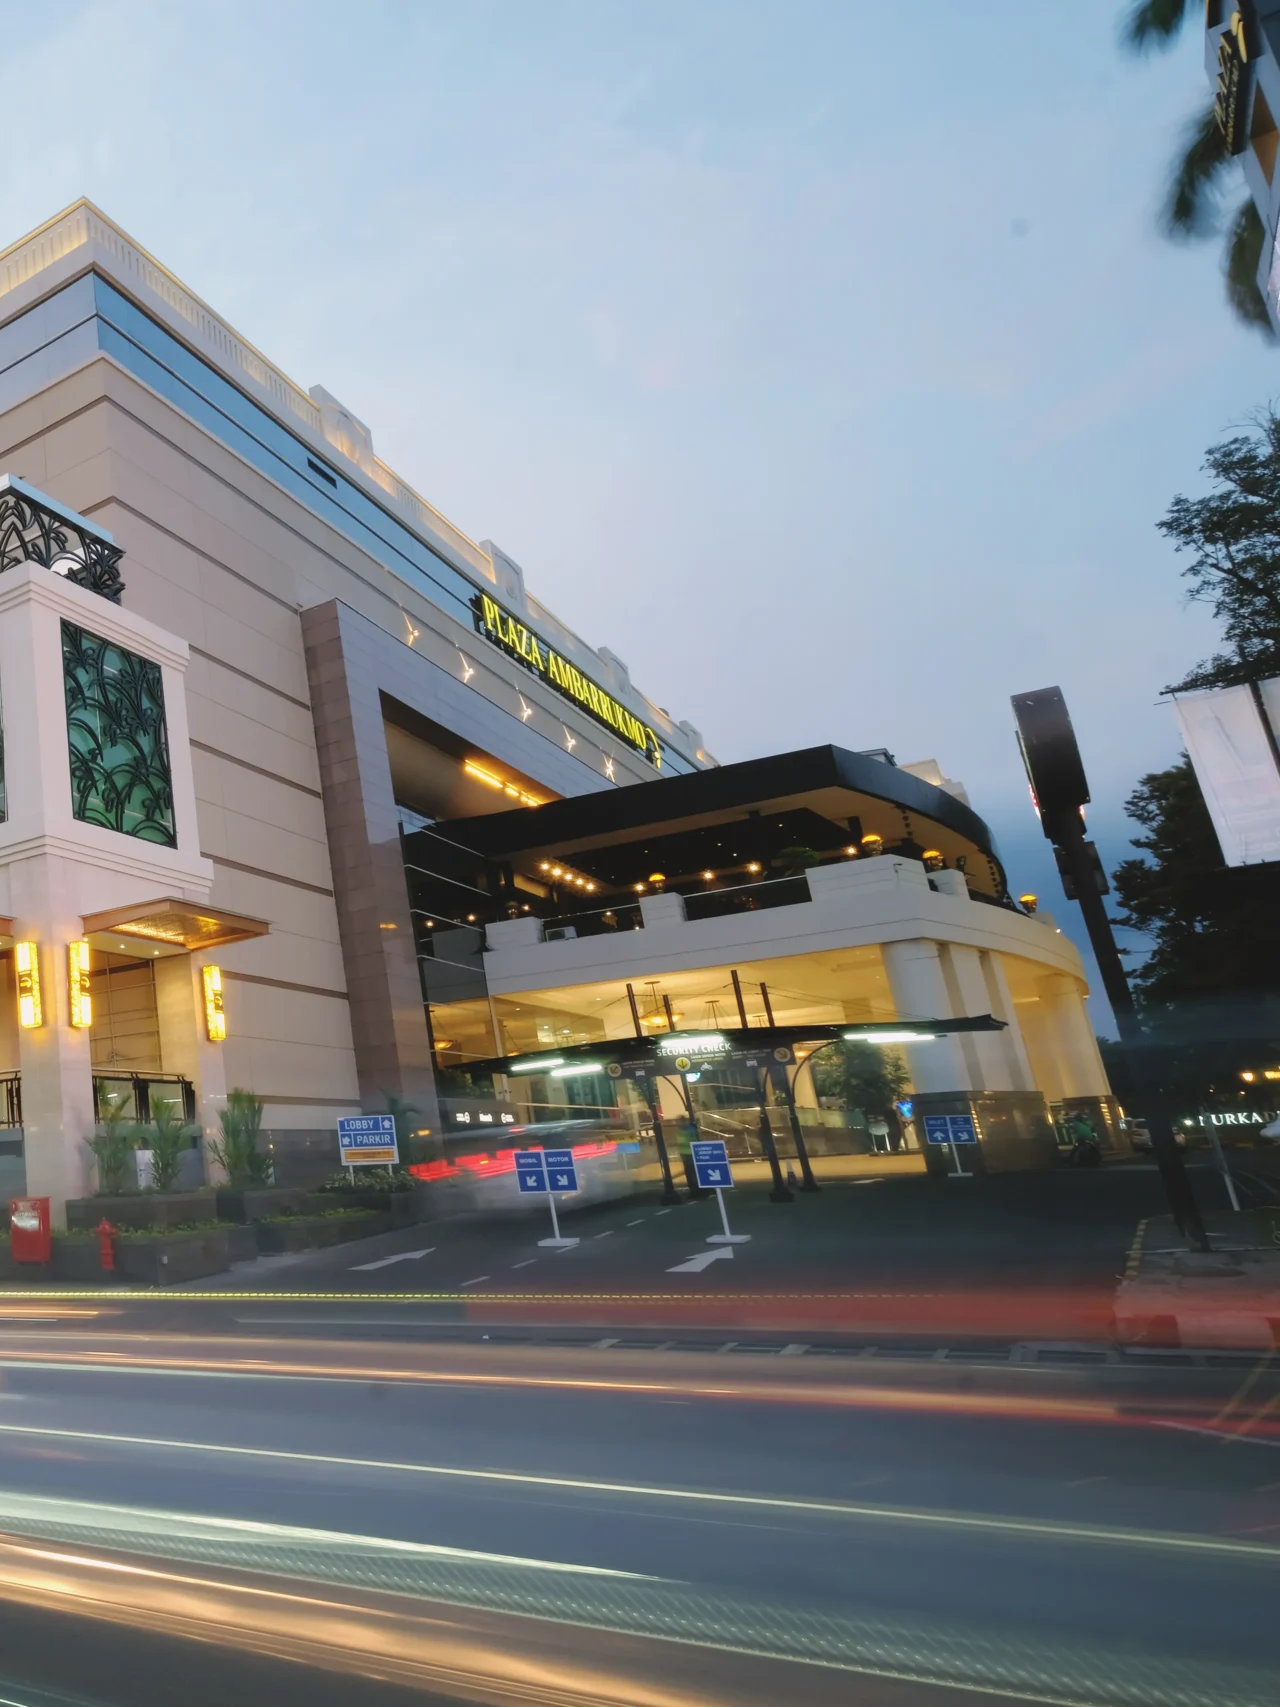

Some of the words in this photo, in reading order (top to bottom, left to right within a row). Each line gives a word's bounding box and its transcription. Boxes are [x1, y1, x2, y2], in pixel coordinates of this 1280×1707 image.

[481, 593, 545, 671] PLAZA
[548, 650, 647, 750] AMBARRUKMO
[656, 1045, 699, 1057] SECURITY
[701, 1042, 732, 1053] CHECK
[344, 1119, 374, 1130] LOBBY
[356, 1134, 391, 1144] PARKIR
